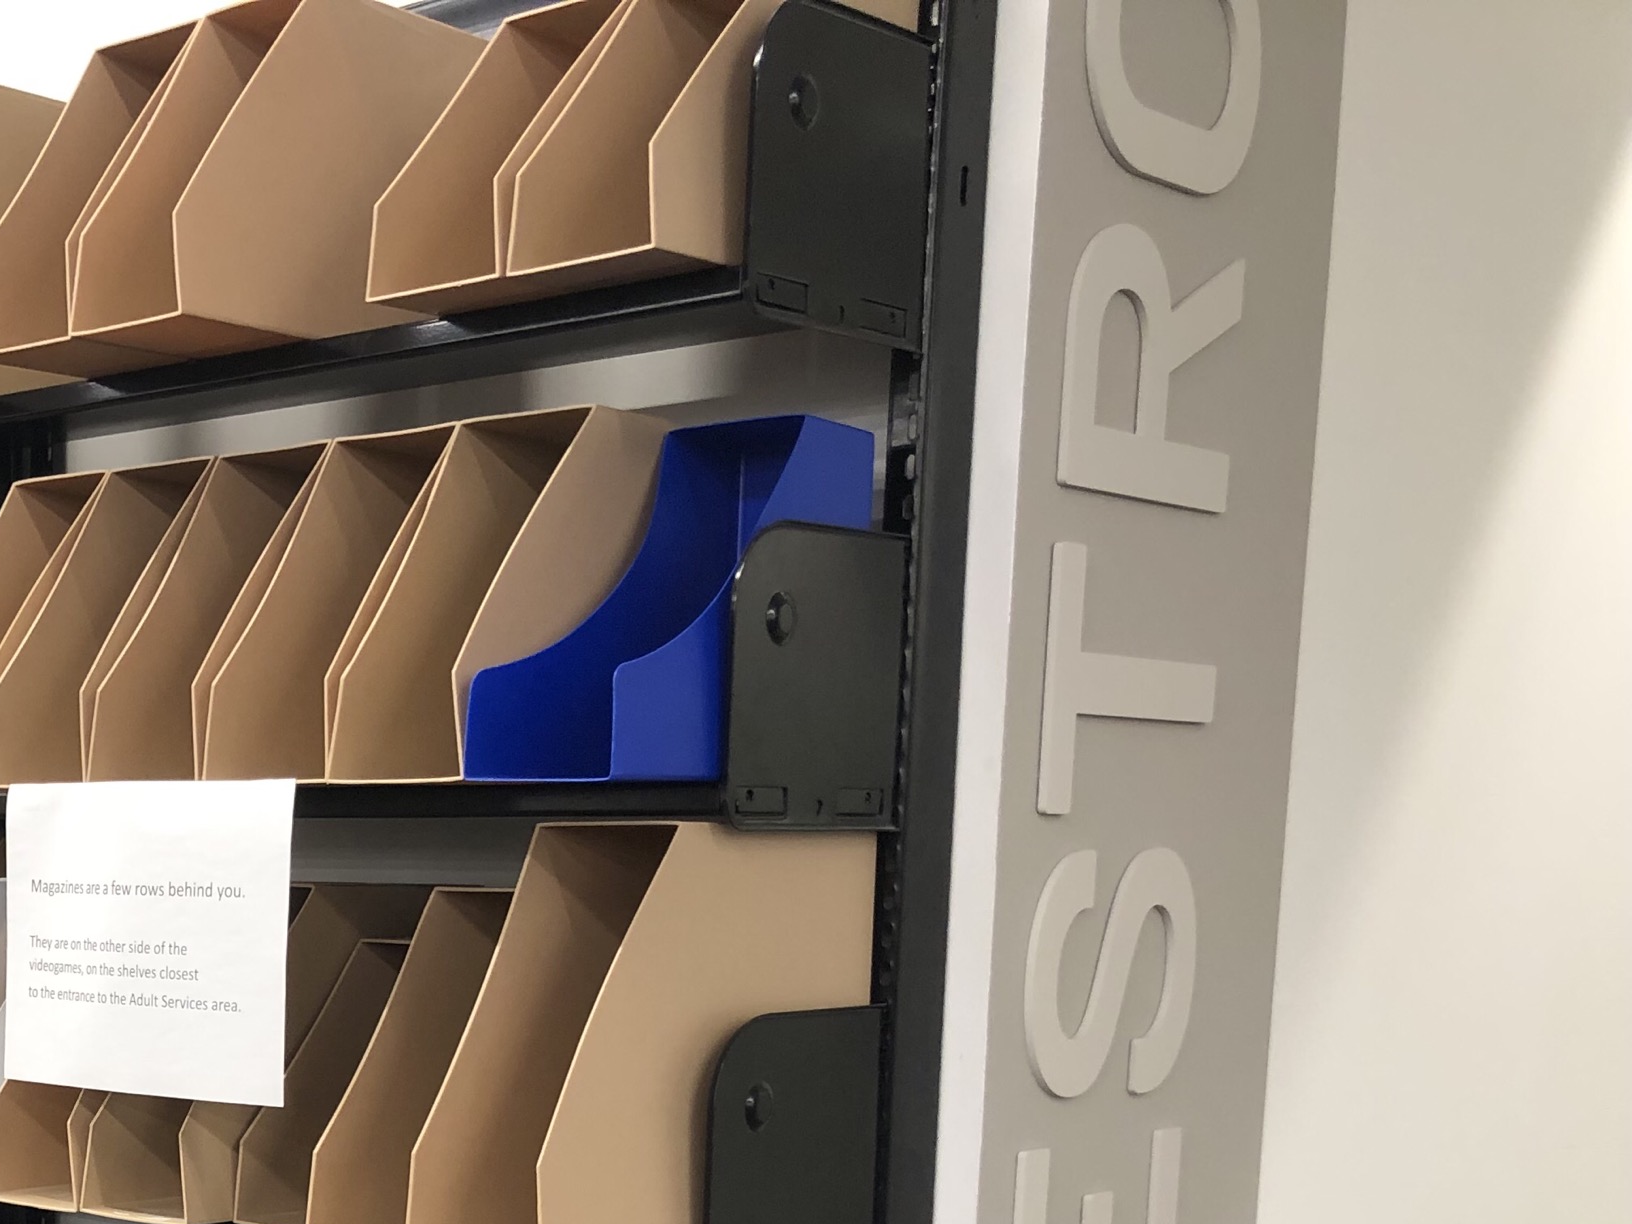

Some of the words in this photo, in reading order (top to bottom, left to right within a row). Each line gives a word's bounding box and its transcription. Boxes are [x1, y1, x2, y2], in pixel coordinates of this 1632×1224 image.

[31, 879, 83, 897] Magazines
[86, 883, 100, 895] are
[103, 884, 108, 895] a
[111, 881, 131, 896] few
[135, 884, 164, 897] rows
[169, 882, 212, 898] behind
[217, 887, 245, 901] you.
[30, 935, 52, 951] They
[54, 939, 68, 950] are
[71, 941, 81, 951] on
[84, 938, 97, 952] the
[100, 939, 125, 953] other
[128, 941, 151, 954] side
[154, 941, 166, 955] of
[168, 942, 187, 956] the
[29, 959, 84, 976] videogames,
[86, 965, 97, 975] on
[100, 963, 115, 976] the
[117, 964, 156, 979] shelves
[160, 966, 199, 981] closest
[28, 987, 38, 998] to
[41, 987, 55, 1000] the
[57, 989, 95, 1003] entrance
[97, 992, 107, 1004] to
[110, 991, 126, 1005] the
[129, 993, 158, 1007] Adult
[161, 996, 208, 1010] Services
[211, 1000, 241, 1013] area.
